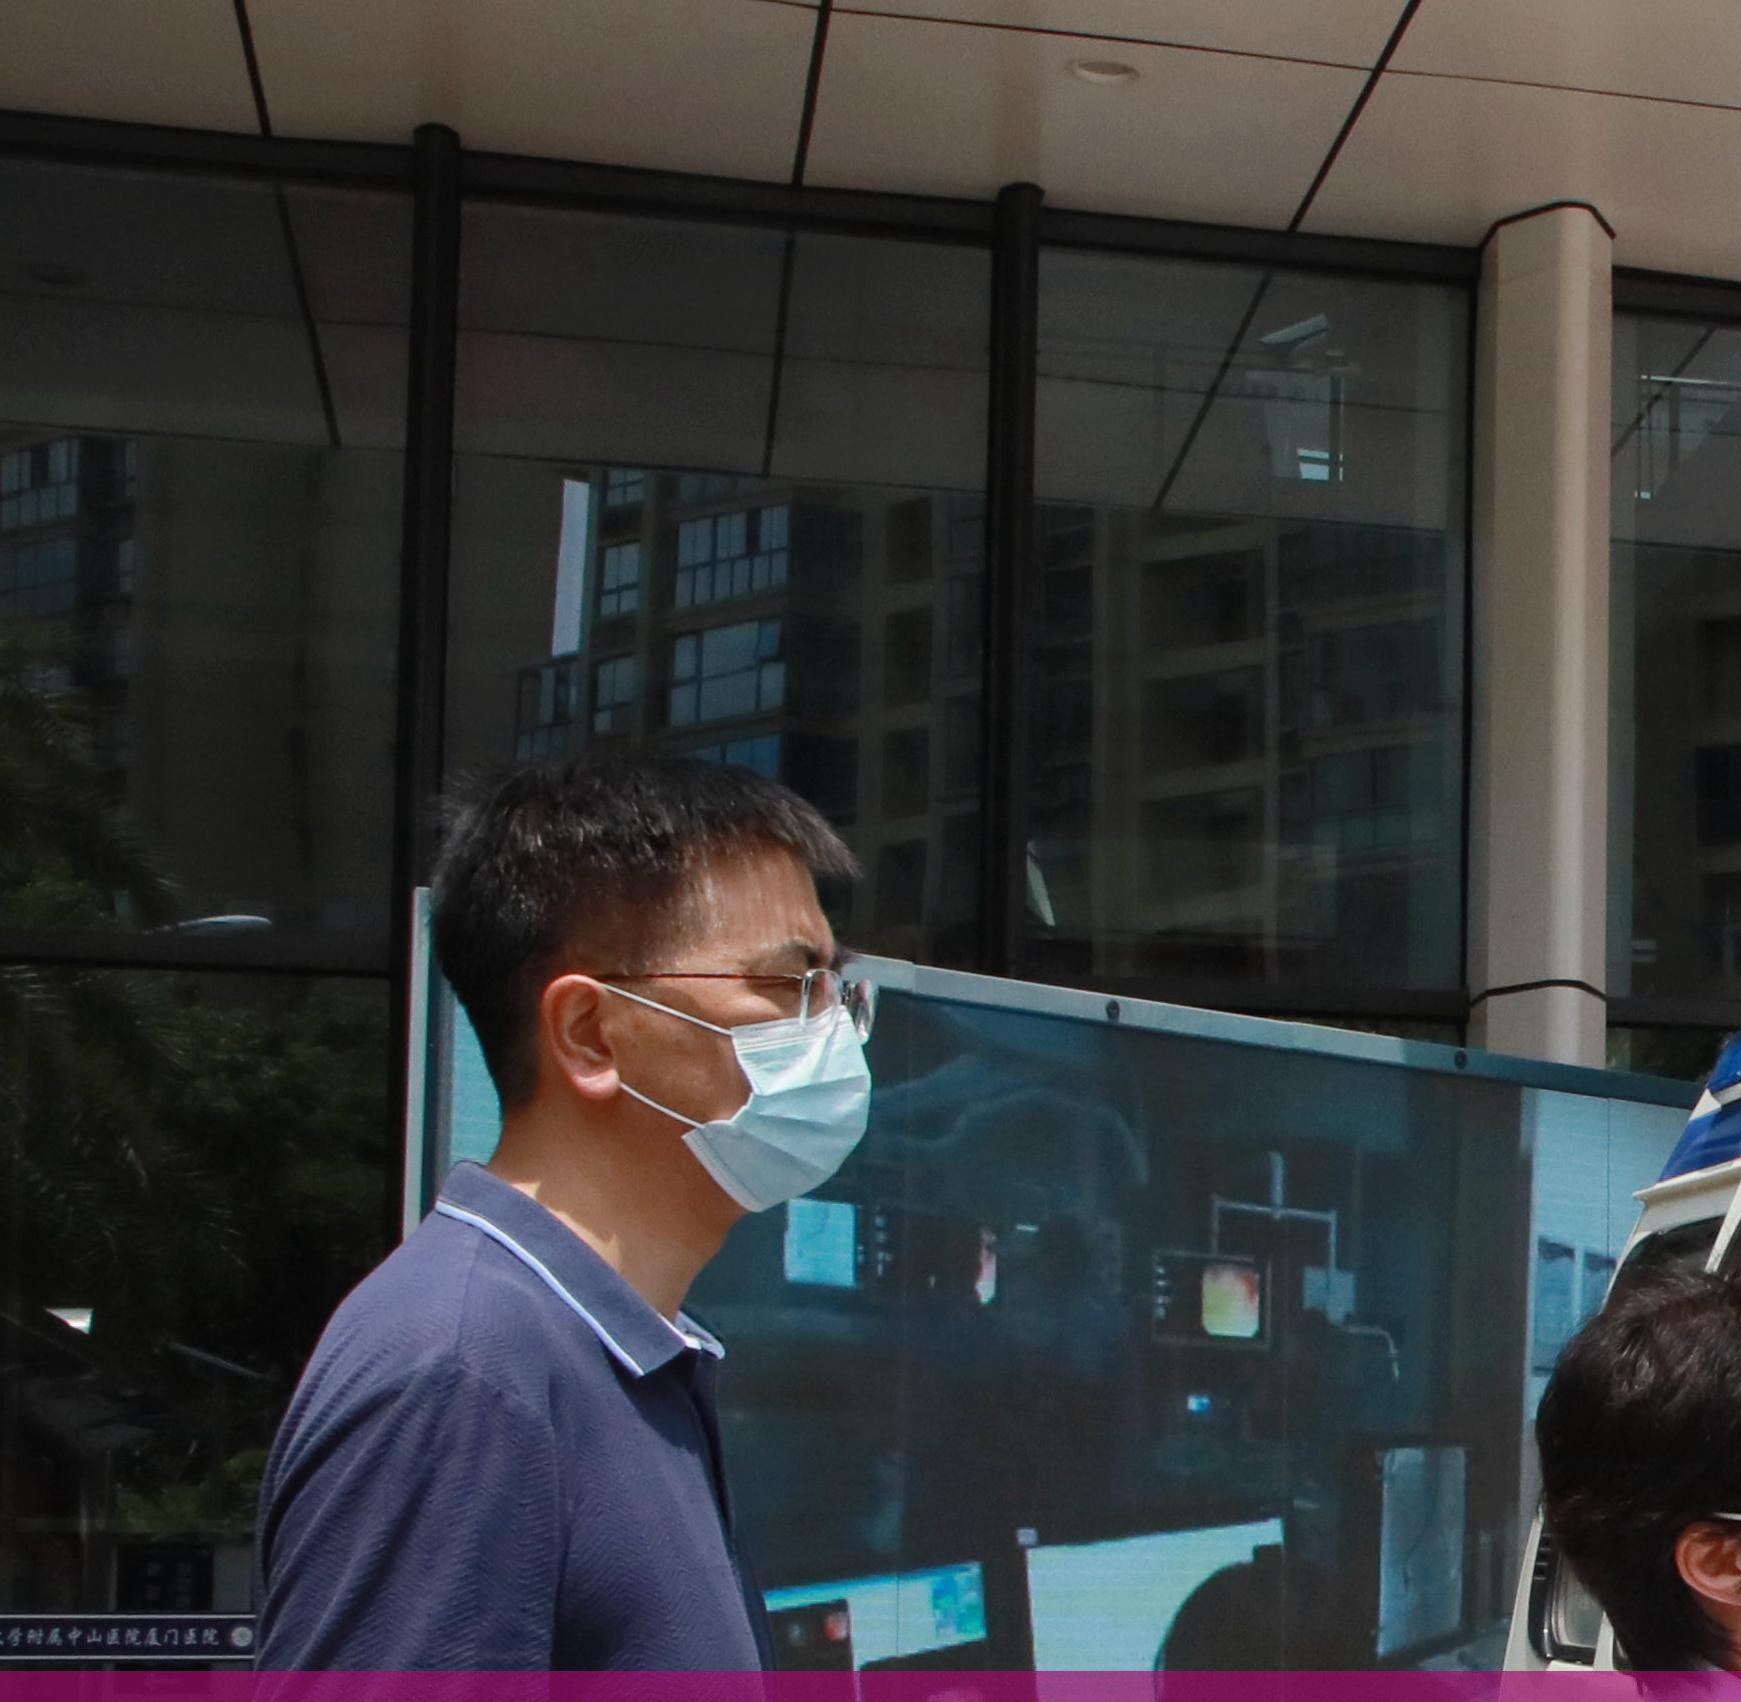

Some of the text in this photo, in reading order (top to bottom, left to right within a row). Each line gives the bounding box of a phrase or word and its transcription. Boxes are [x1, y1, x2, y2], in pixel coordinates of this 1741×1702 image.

[0, 1626, 220, 1647] 学附属中山医院厦门医院
